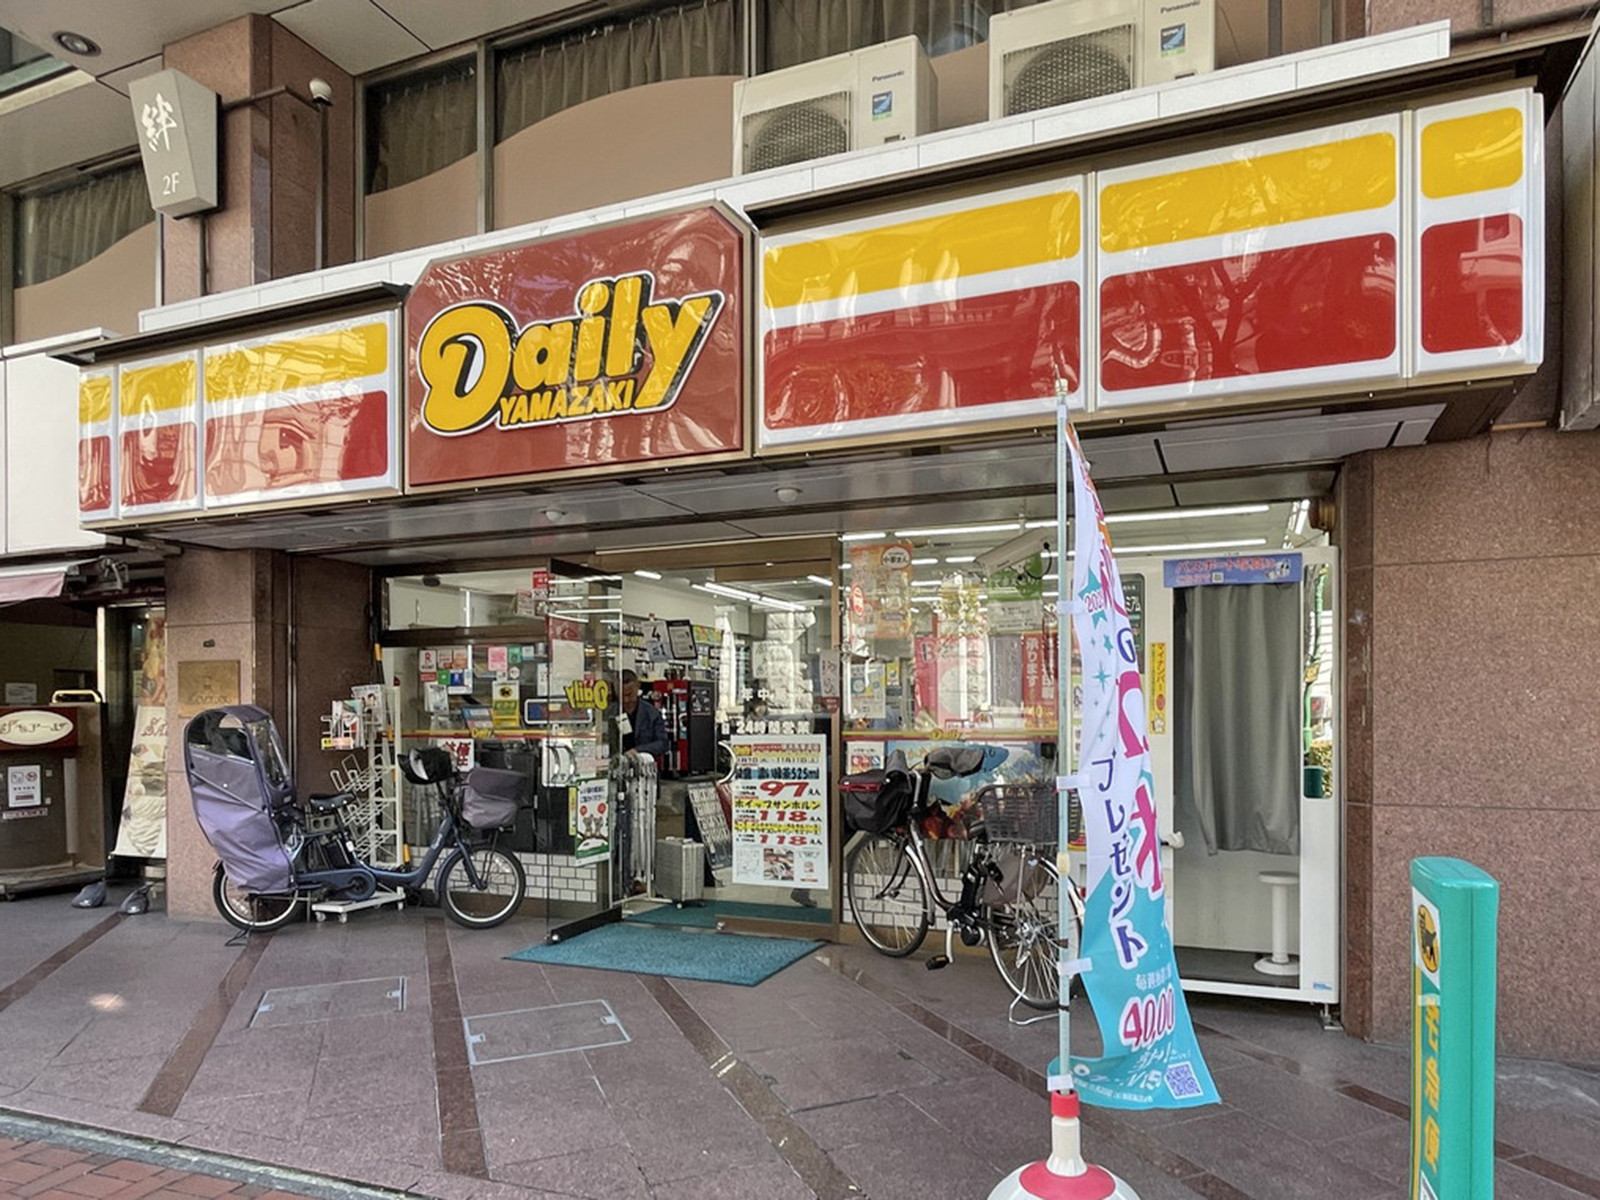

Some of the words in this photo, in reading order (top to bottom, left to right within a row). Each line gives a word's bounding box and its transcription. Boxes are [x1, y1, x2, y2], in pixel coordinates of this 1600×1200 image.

[163, 172, 180, 195] 2F
[419, 273, 720, 432] Daily
[501, 379, 635, 425] YAMAZAKI
[760, 780, 810, 797] 97
